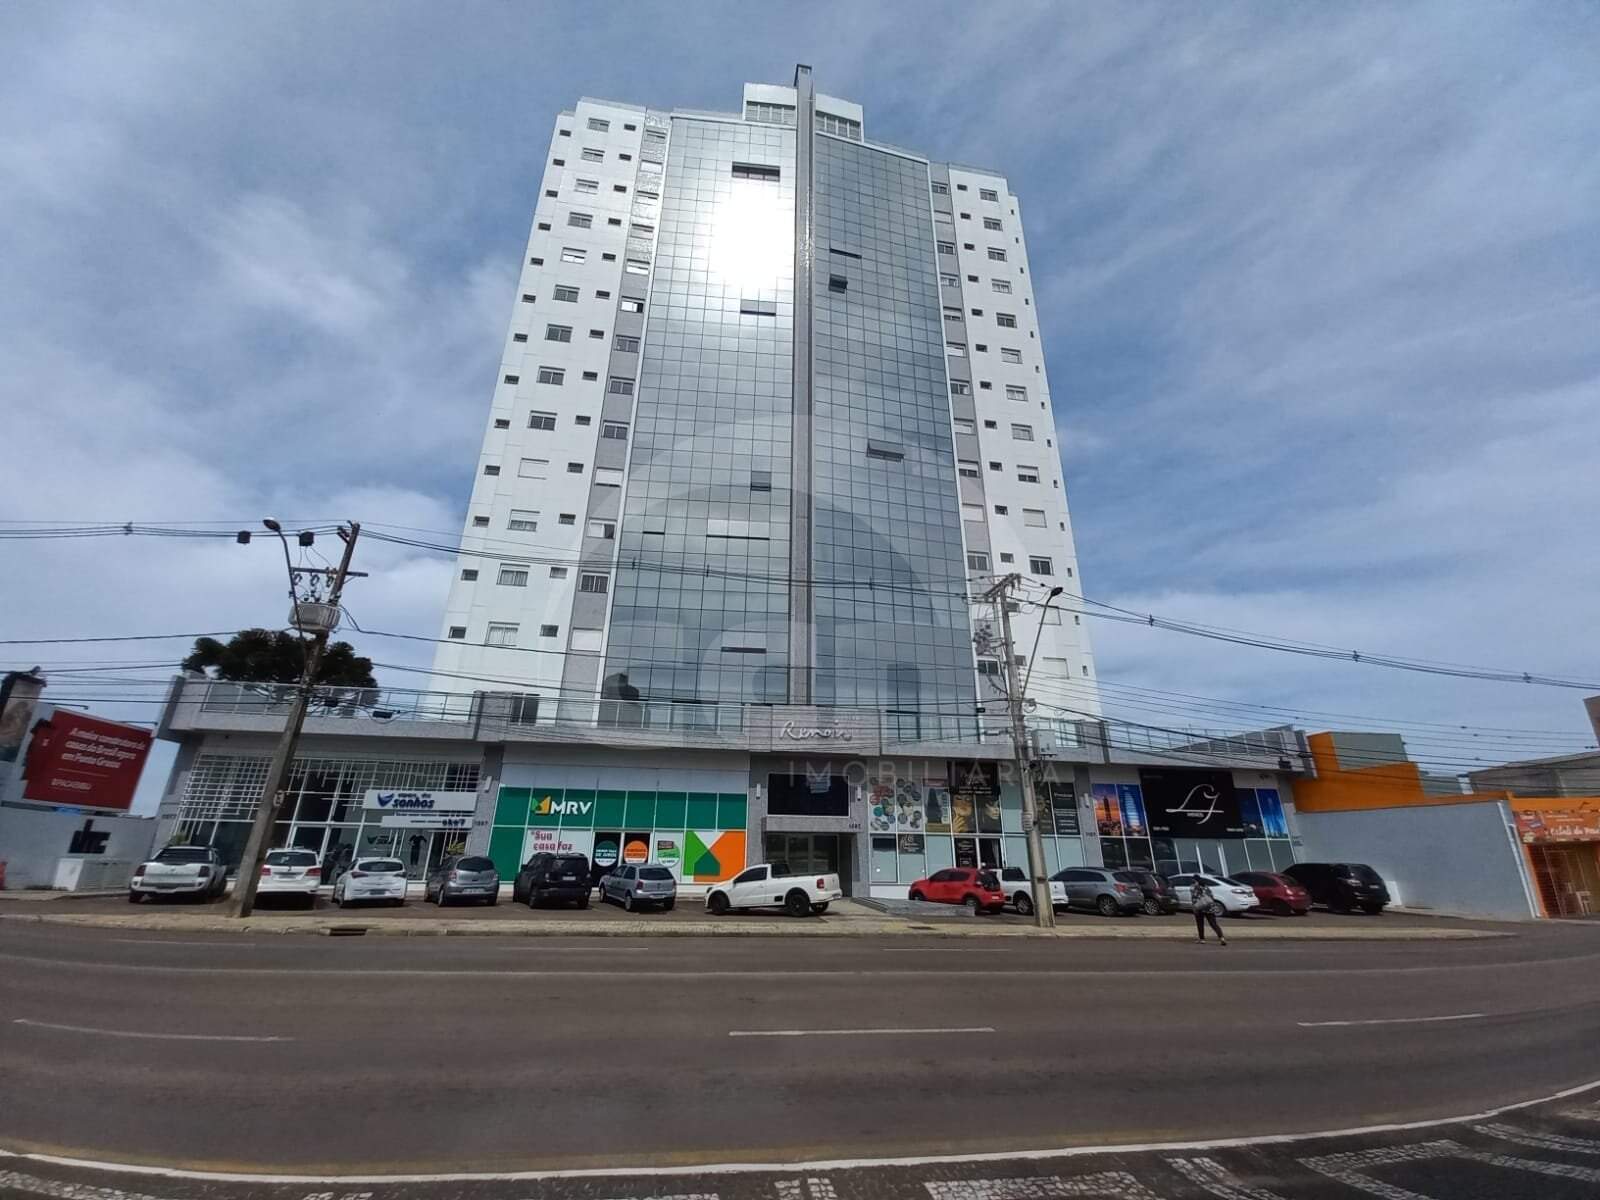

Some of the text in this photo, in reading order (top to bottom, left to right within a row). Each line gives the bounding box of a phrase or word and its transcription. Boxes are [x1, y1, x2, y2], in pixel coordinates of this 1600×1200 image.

[392, 797, 435, 809] sonhos
[550, 801, 592, 815] MRV
[533, 842, 556, 851] casa
